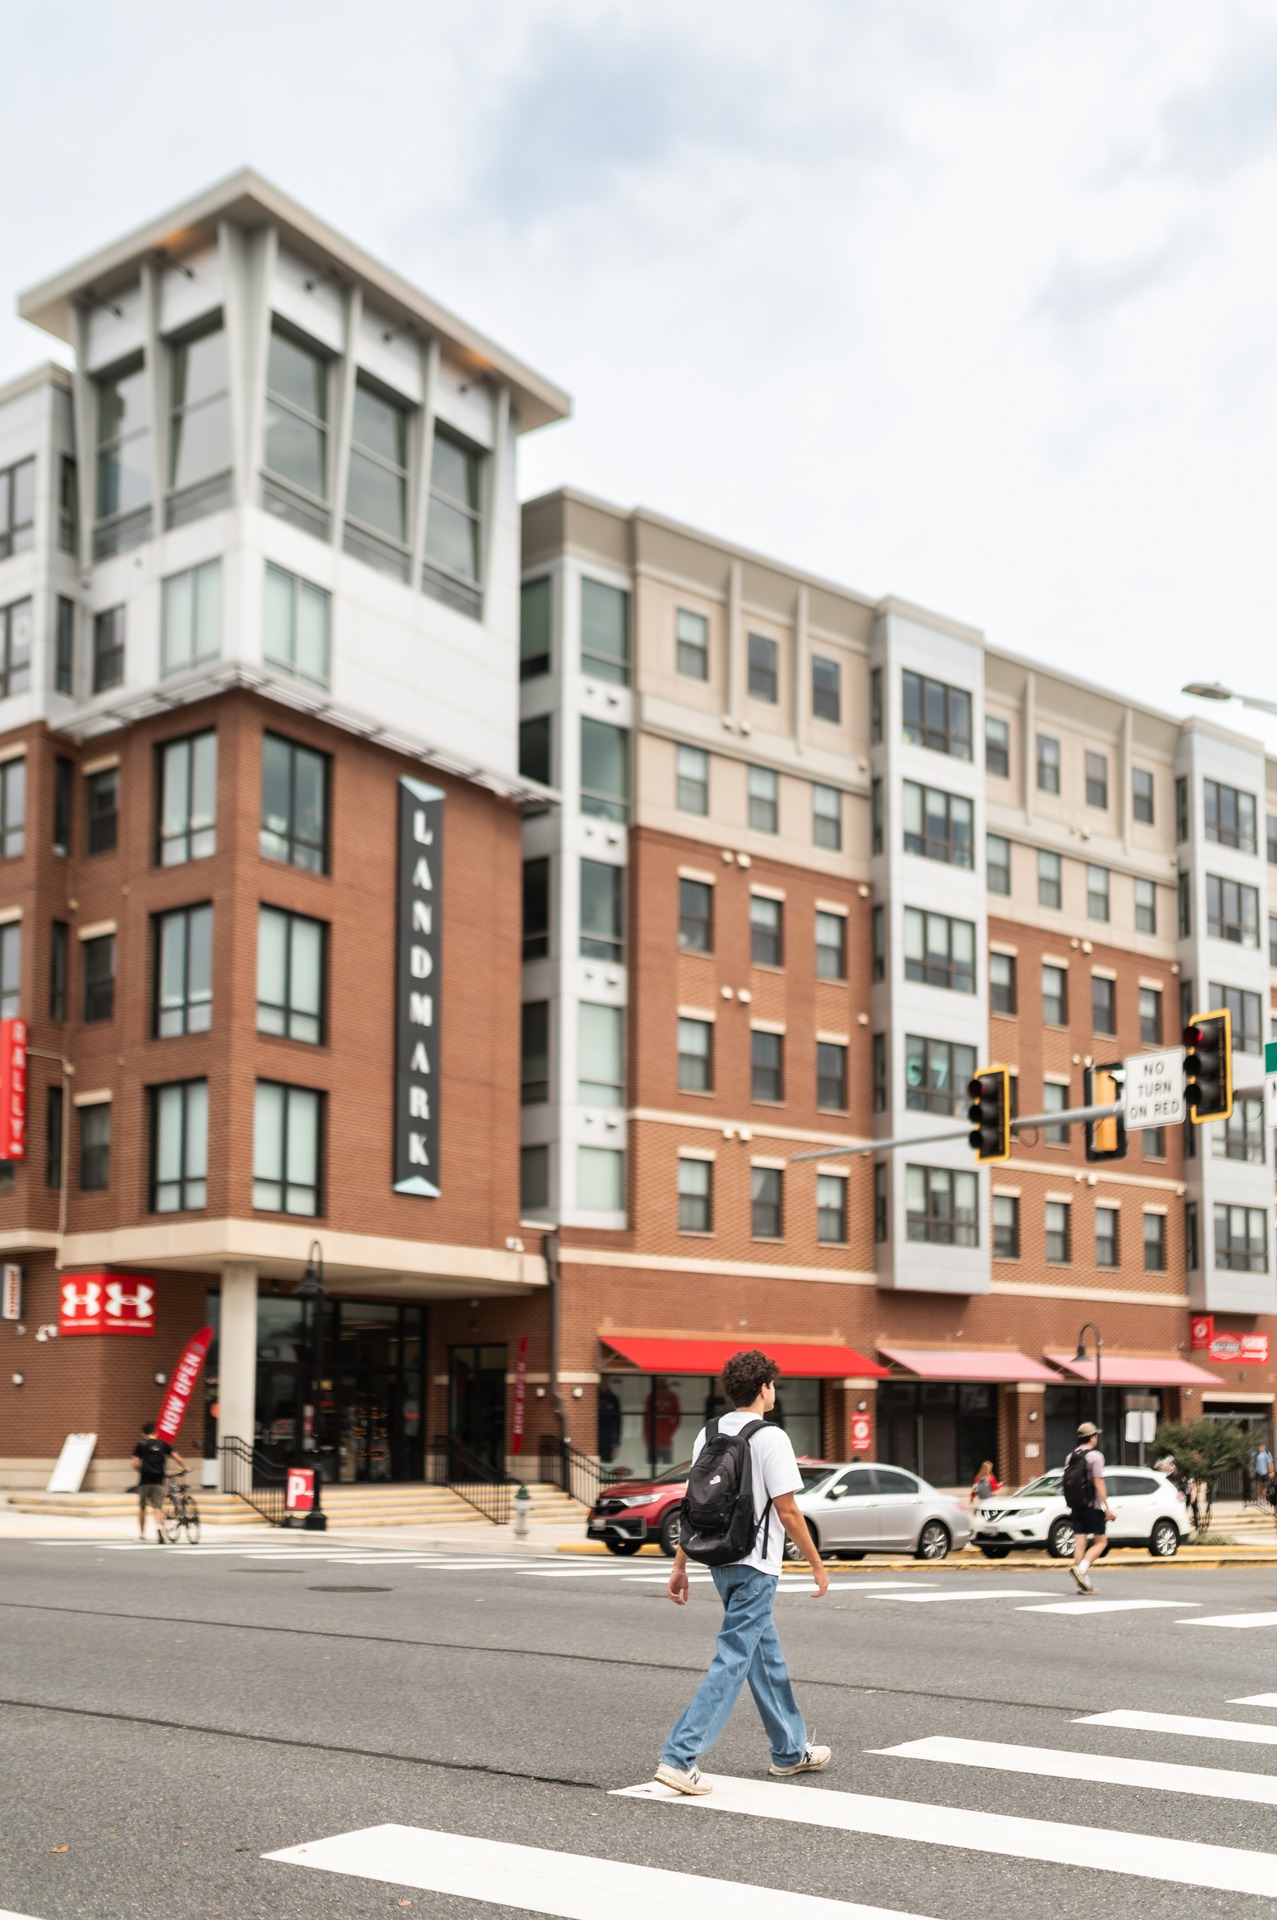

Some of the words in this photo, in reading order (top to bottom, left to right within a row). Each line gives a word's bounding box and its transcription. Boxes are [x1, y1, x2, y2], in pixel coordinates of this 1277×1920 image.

[409, 809, 434, 1166] LANDMARK
[1144, 1061, 1165, 1077] NO
[1138, 1081, 1172, 1097] TURN
[1130, 1105, 1147, 1121] ON
[1154, 1100, 1180, 1116] RED
[159, 1394, 186, 1436] NOW
[173, 1352, 201, 1396] OPEN
[287, 1476, 307, 1508] P
[690, 1772, 700, 1785] N
